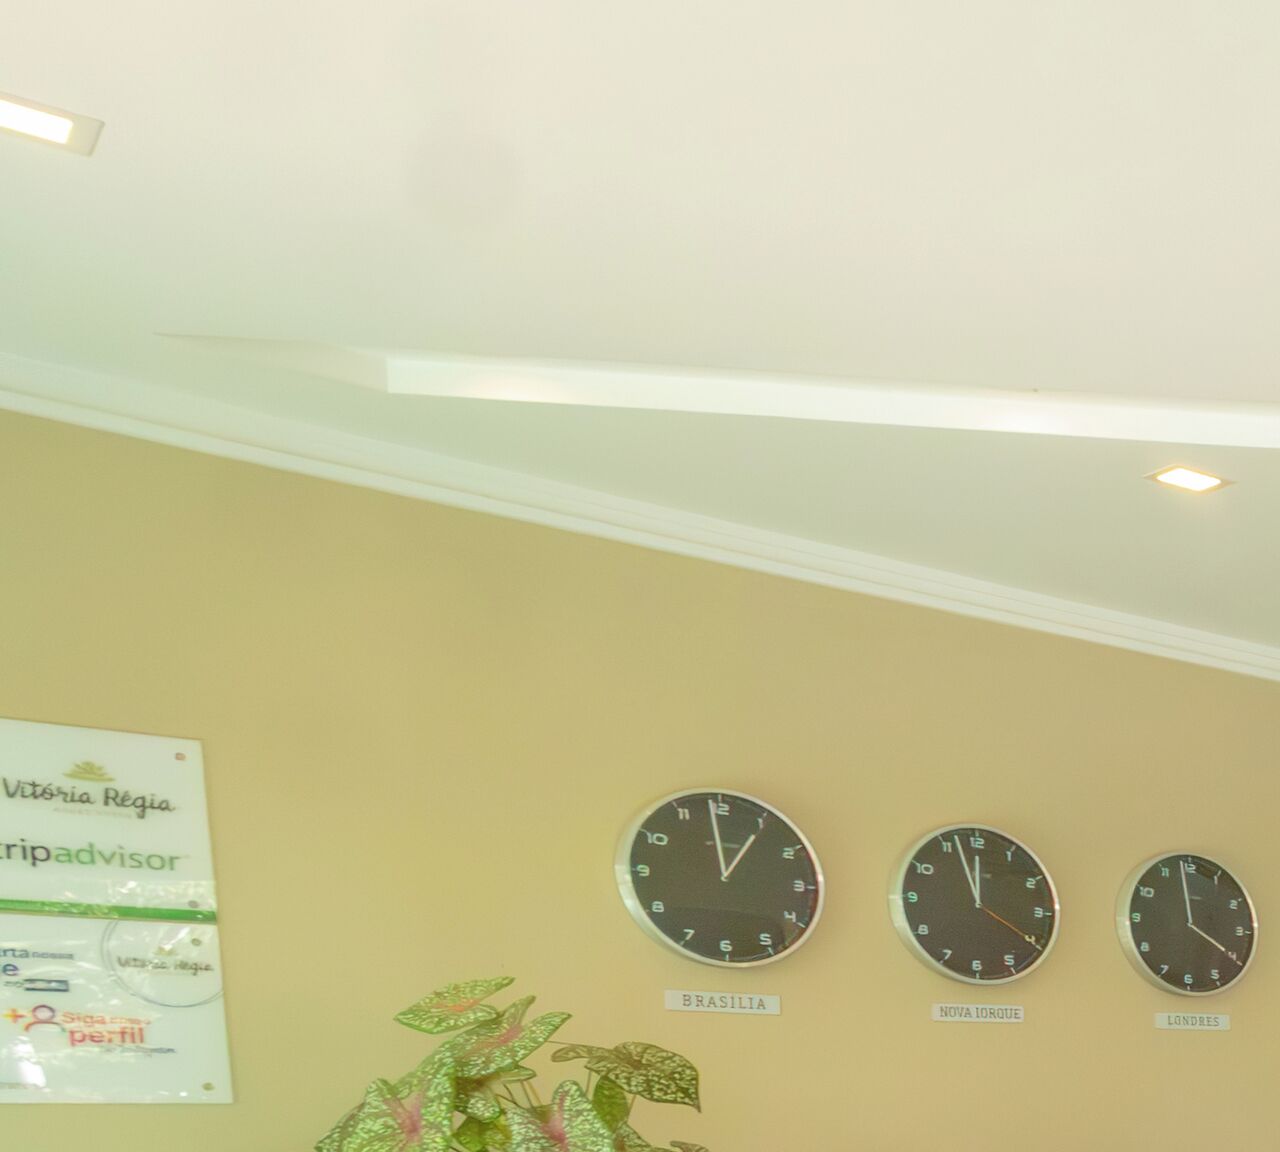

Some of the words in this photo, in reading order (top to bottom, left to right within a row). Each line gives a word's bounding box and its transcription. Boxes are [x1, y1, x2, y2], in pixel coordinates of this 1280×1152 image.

[2, 777, 96, 805] Vitória
[103, 787, 177, 820] Régia
[677, 807, 690, 820] 11
[648, 832, 668, 846] 10
[970, 837, 985, 849] 12
[782, 847, 795, 860] 2
[637, 864, 650, 877] 9
[916, 863, 934, 875] 10
[793, 880, 806, 892] 3
[1025, 878, 1037, 889] 2
[907, 891, 918, 902] 9
[651, 901, 665, 913] 8
[1034, 907, 1044, 918] 3
[783, 910, 797, 923] 4
[1131, 912, 1141, 923] 9
[683, 929, 695, 940] 7
[918, 924, 929, 935] 8
[759, 933, 772, 946] 5
[719, 940, 733, 952] 6
[942, 949, 952, 960] 7
[1004, 955, 1015, 966] 5
[972, 960, 982, 971] 6
[940, 1006, 973, 1018] NOVA
[975, 1007, 1022, 1019] IORQUE
[1167, 1015, 1220, 1027] LONDRES
[69, 1026, 145, 1047] perfil
